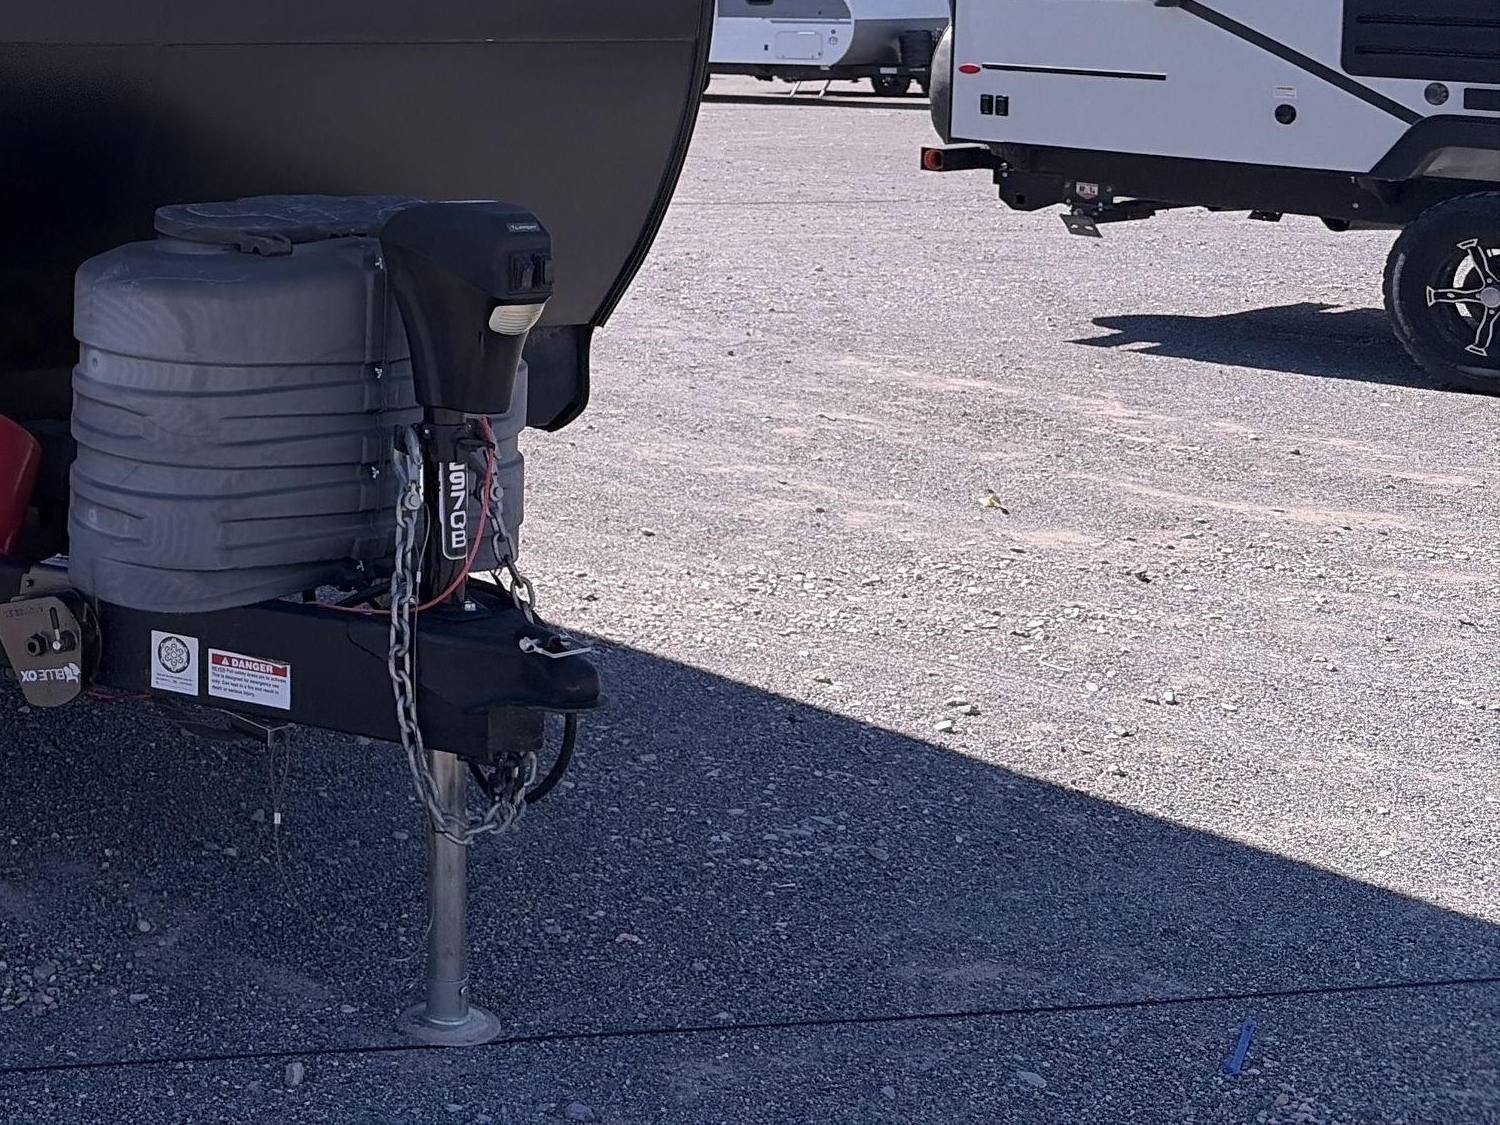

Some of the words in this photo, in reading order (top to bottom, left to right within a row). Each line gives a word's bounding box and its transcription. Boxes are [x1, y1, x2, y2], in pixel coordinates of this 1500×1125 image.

[231, 658, 274, 674] DANGER
[20, 670, 38, 682] OX
[39, 668, 65, 681] BLUE
